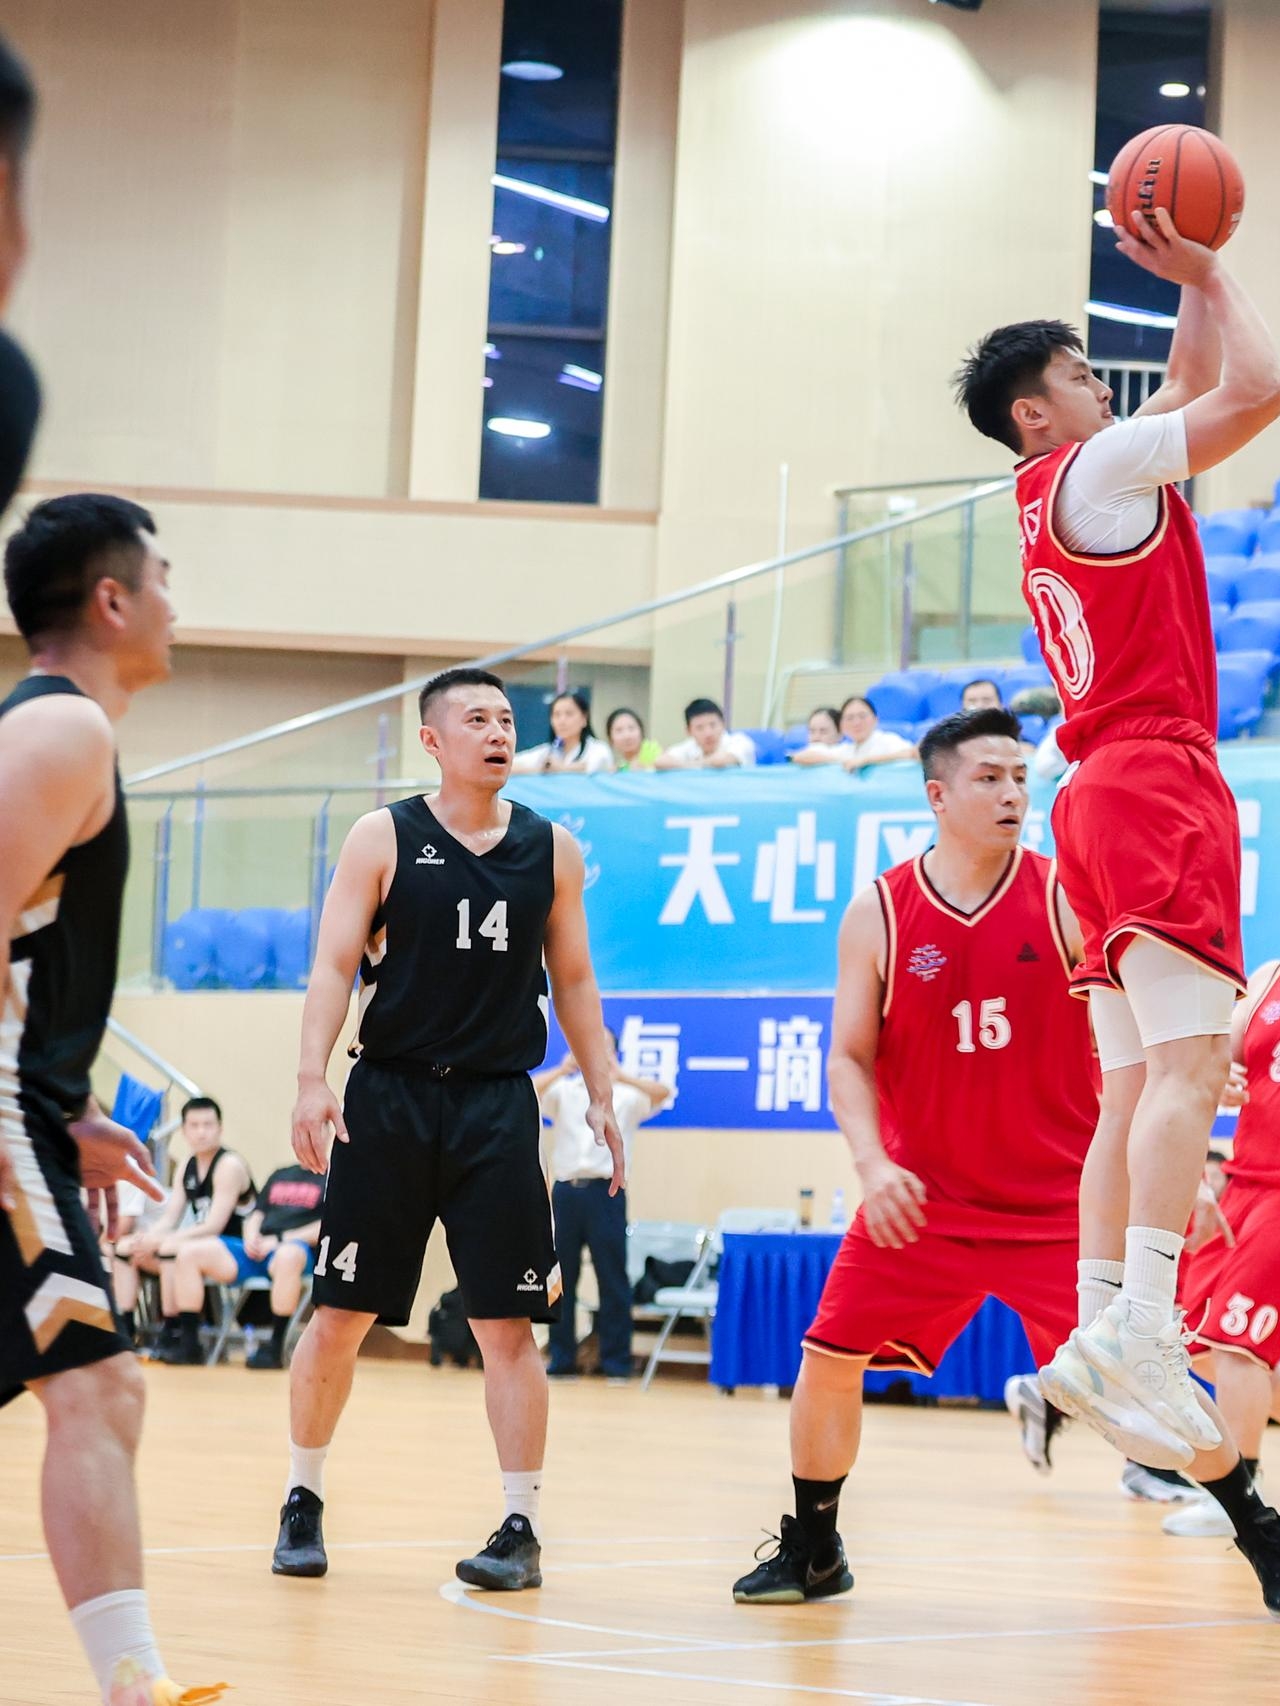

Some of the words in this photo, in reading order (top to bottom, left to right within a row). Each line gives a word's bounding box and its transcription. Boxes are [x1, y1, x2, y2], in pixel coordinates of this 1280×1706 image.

[456, 898, 509, 952] 14
[952, 996, 1012, 1053] 15
[313, 1235, 360, 1283] 14
[1219, 1291, 1279, 1346] 30
